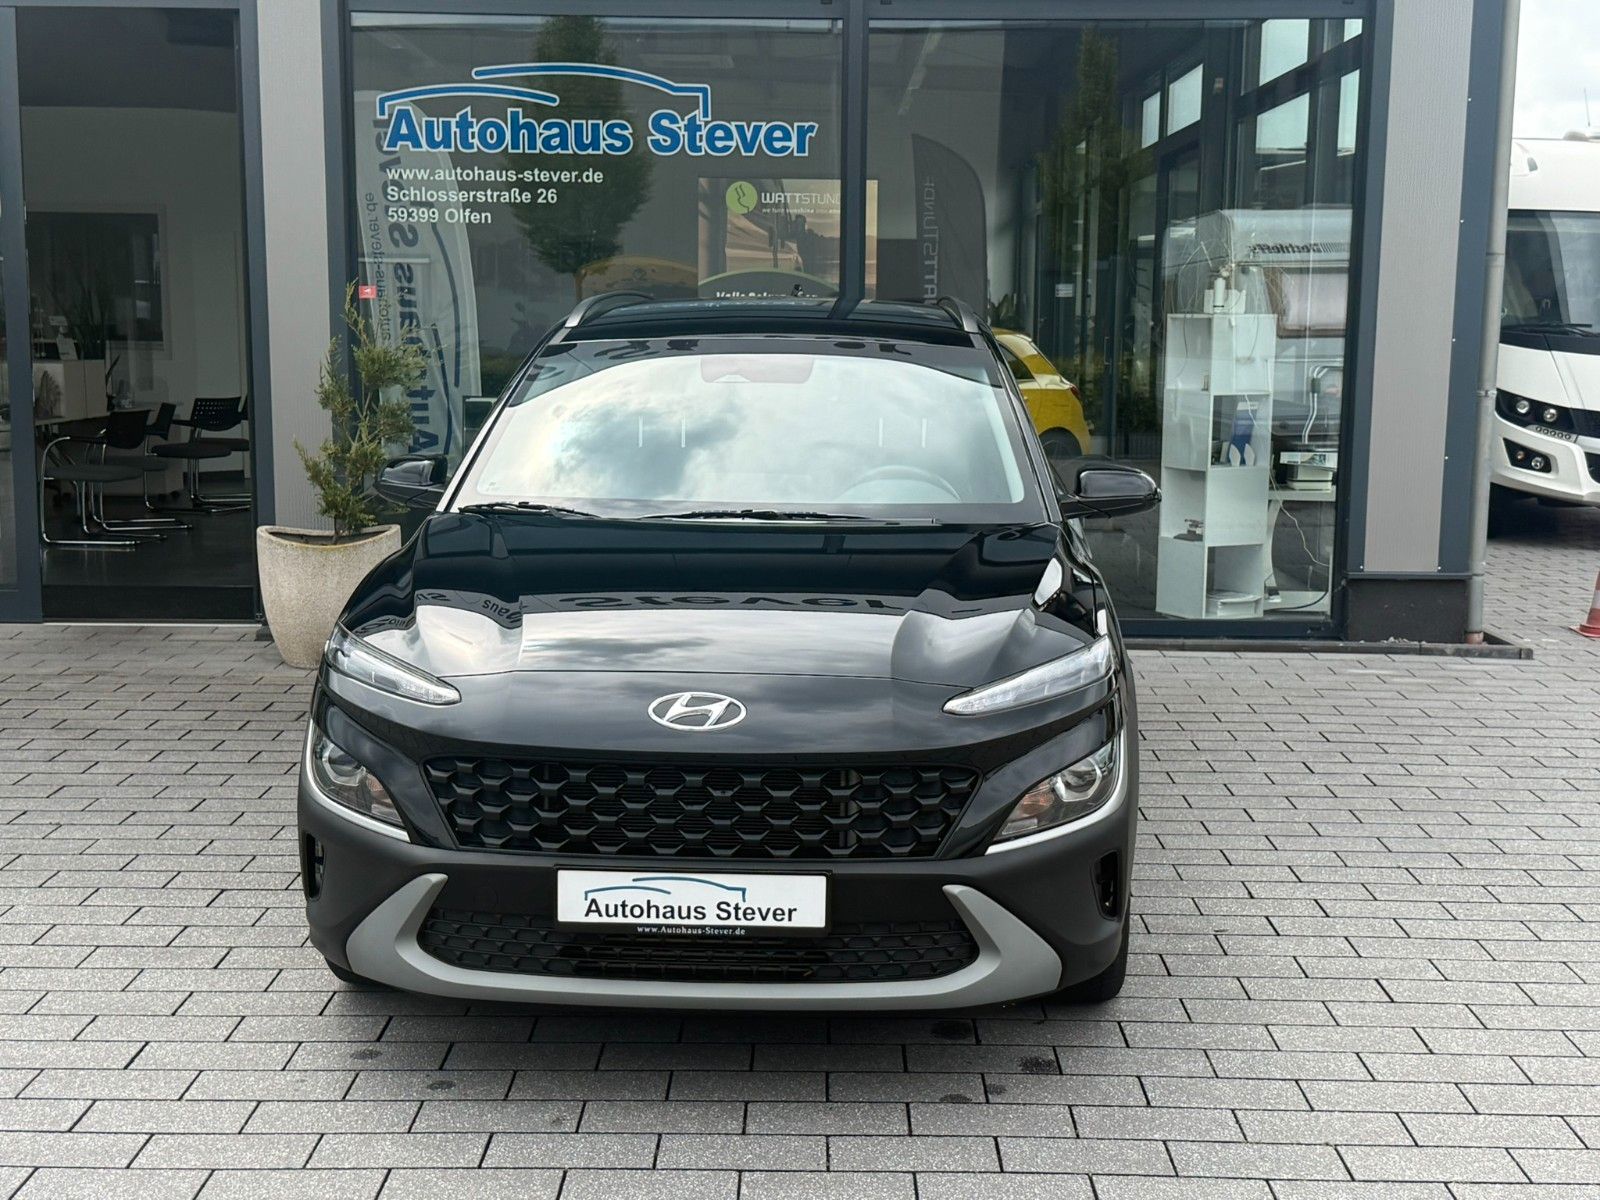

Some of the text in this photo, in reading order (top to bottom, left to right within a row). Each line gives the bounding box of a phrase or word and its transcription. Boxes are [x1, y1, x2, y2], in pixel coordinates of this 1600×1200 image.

[384, 106, 818, 156] Autohaus Stever
[386, 166, 604, 184] www.autohaus-stever.de
[386, 186, 558, 205] Schlosserstraße 26
[387, 207, 493, 225] 59399 Olfen
[584, 898, 798, 922] Autohaus Stever
[636, 926, 747, 937] www.Autohaus-Stever.de
